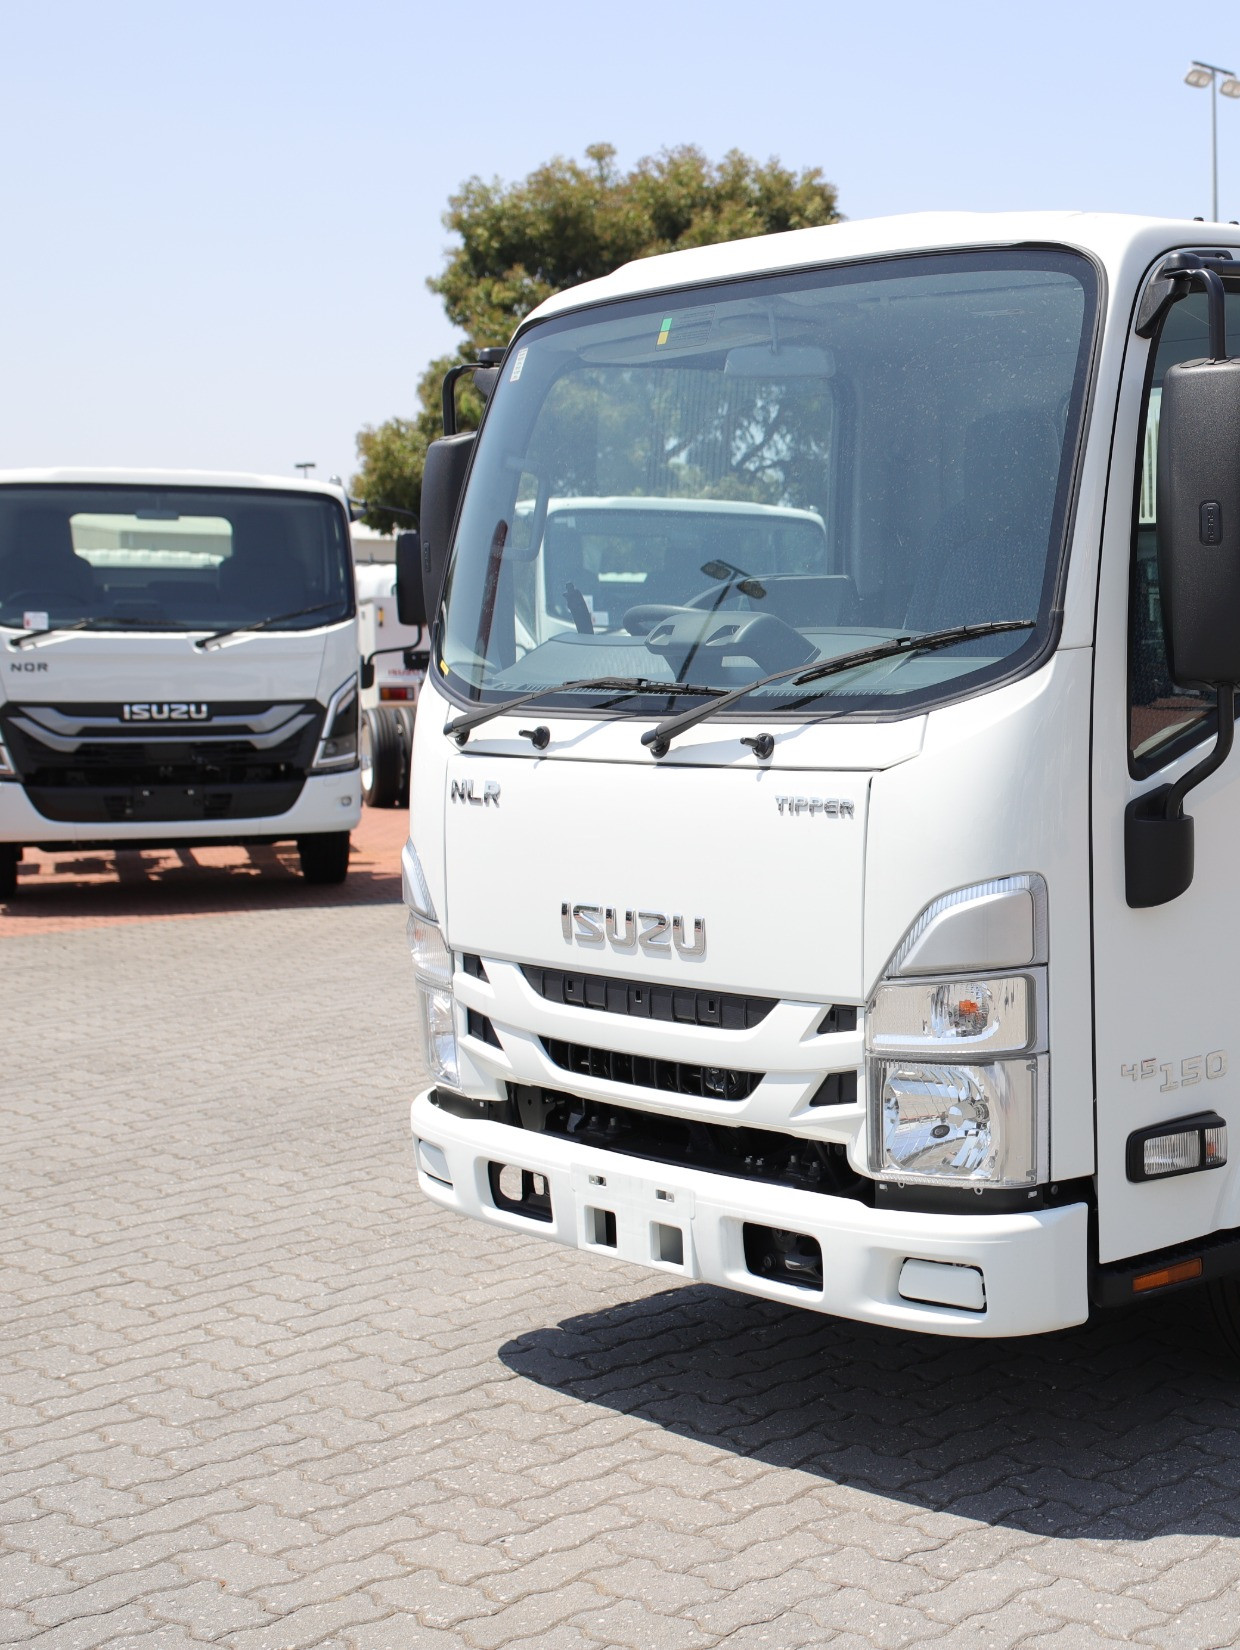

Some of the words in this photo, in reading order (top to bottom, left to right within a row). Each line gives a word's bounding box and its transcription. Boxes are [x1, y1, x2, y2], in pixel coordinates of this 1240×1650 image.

[123, 703, 208, 720] ISUZU
[451, 779, 501, 808] NLR
[775, 795, 855, 820] TIPPER
[561, 901, 707, 959] ISUZU
[1121, 1058, 1157, 1081] 45
[1160, 1050, 1229, 1092] 150
